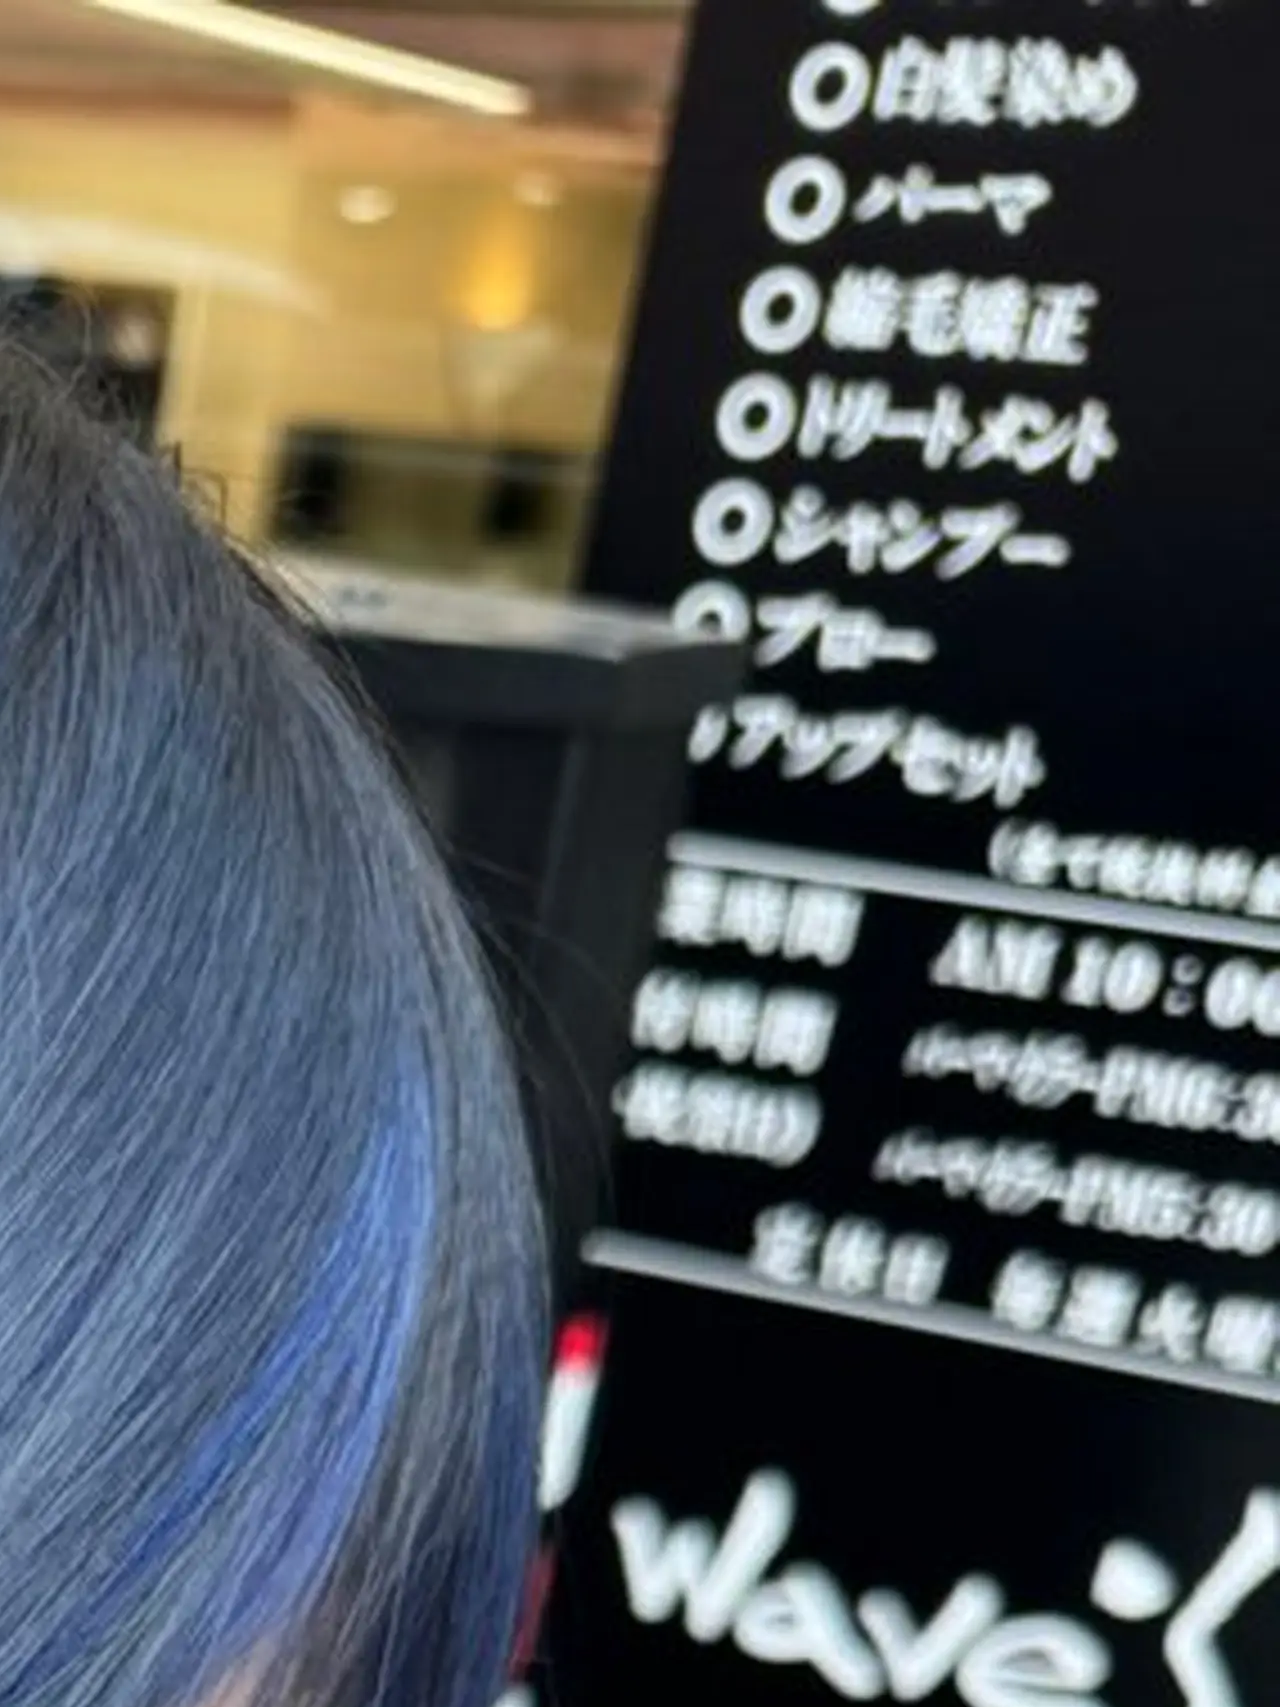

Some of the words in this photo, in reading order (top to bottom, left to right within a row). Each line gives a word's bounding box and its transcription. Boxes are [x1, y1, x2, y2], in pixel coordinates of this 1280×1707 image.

[872, 35, 1138, 127] 白髪染め
[851, 164, 1053, 237] パーマ
[796, 373, 1119, 483] トリートメント
[773, 484, 1071, 579] シャンプー
[752, 591, 937, 672] ブロー
[728, 693, 1045, 809] アップセット
[990, 1248, 1280, 1375] 毎週火曜
